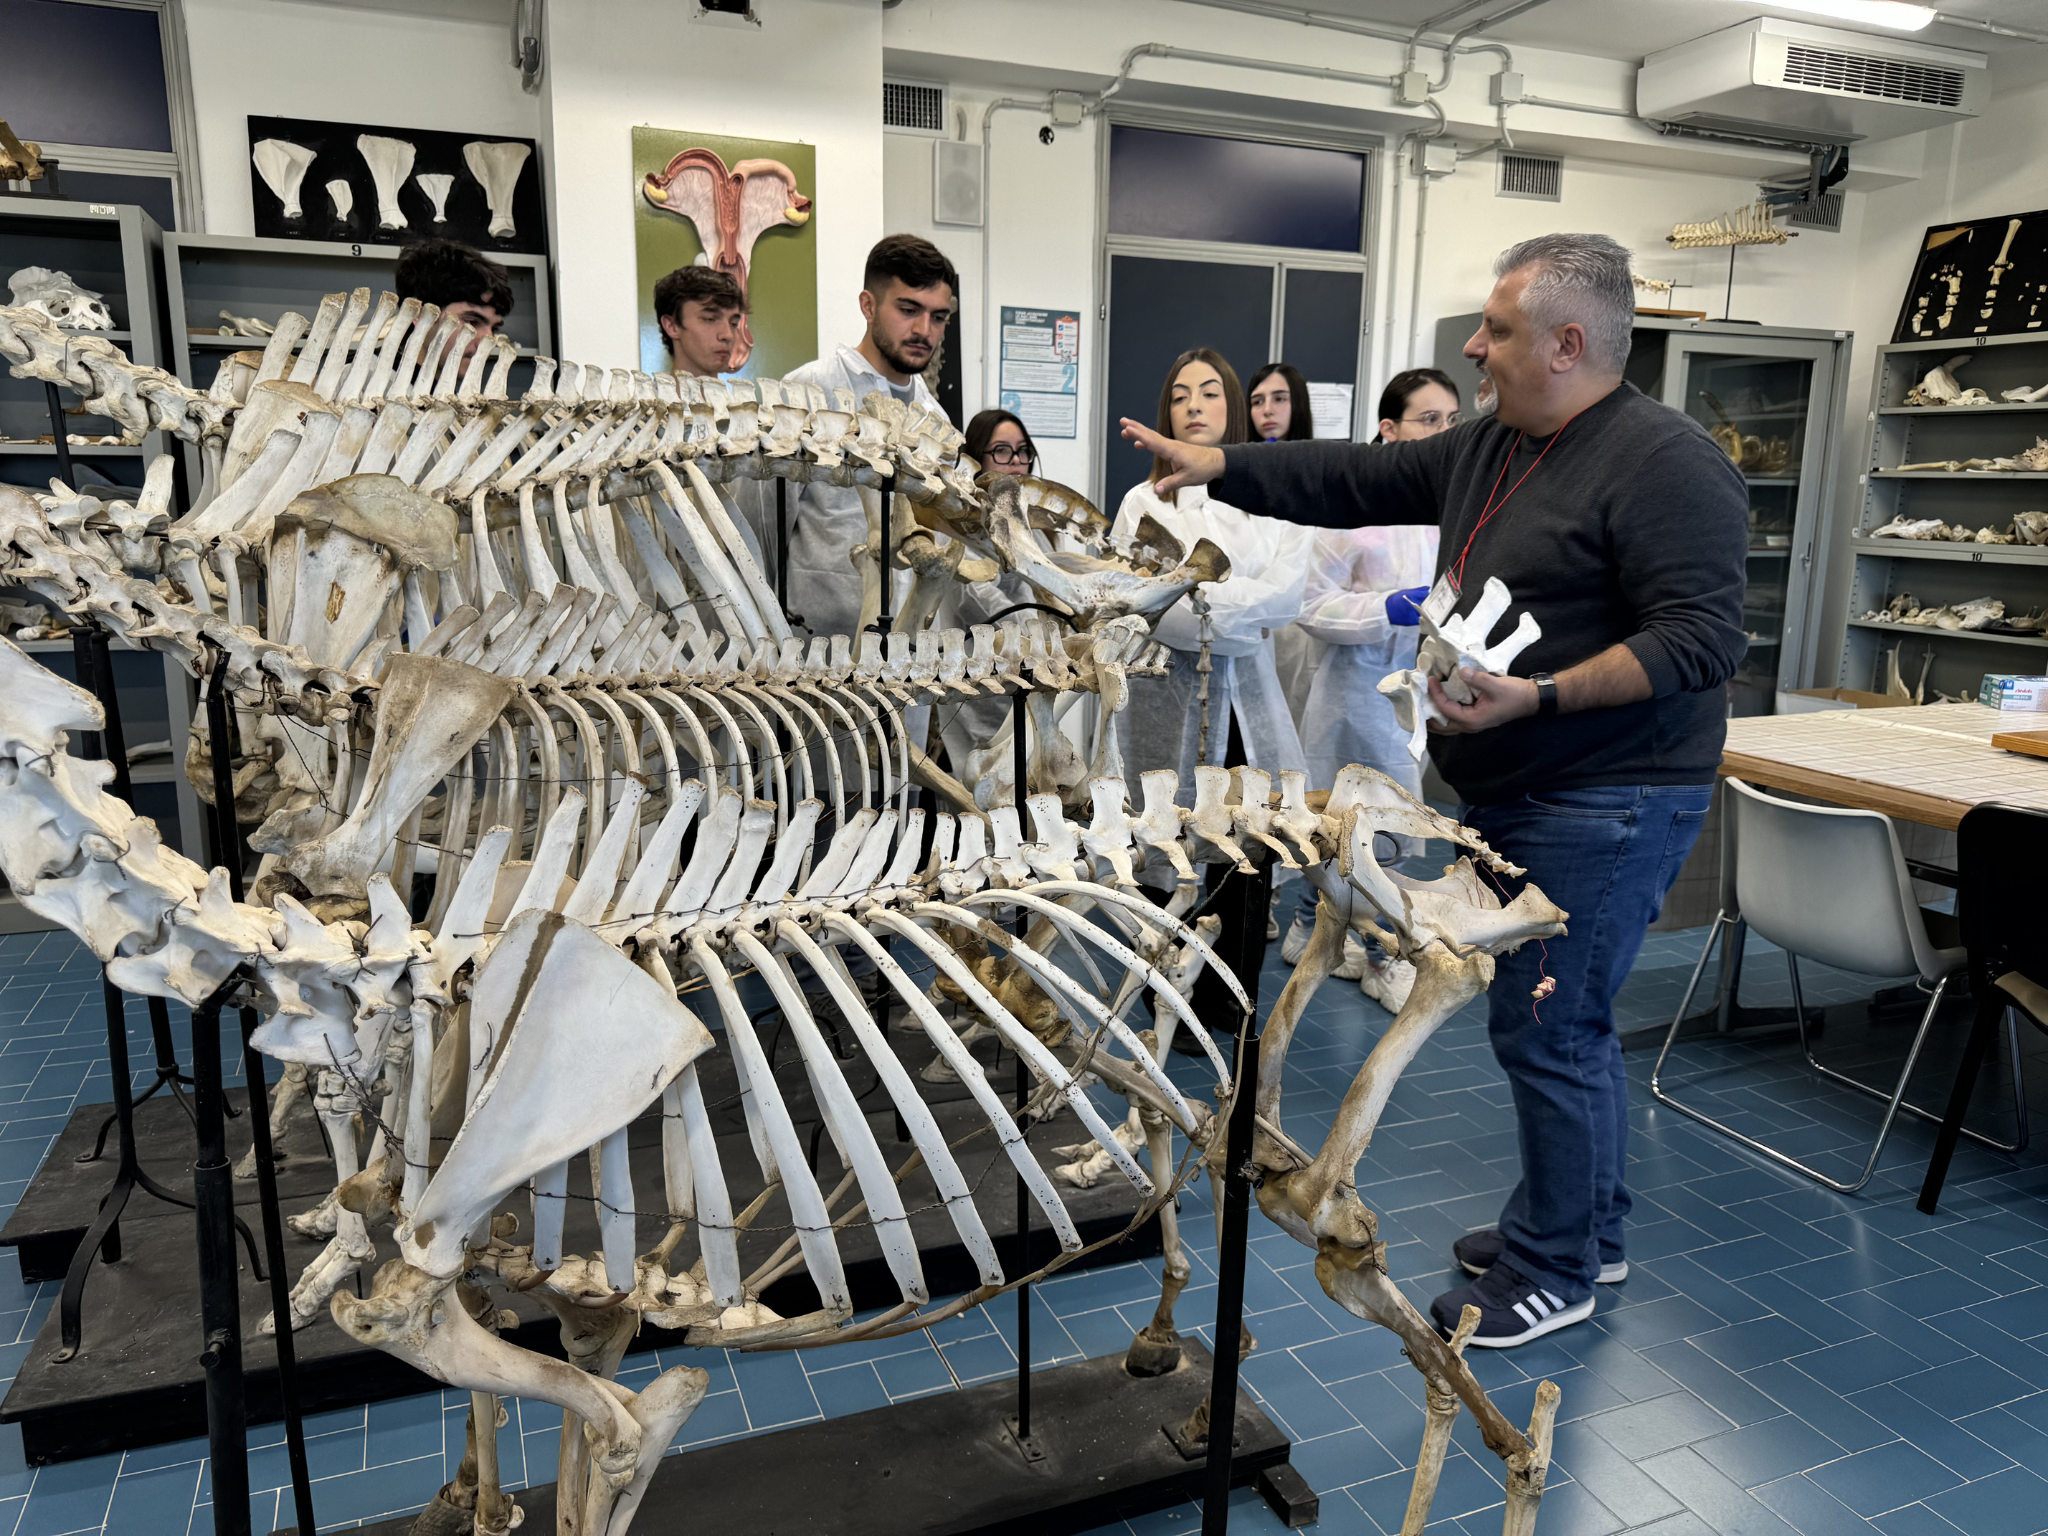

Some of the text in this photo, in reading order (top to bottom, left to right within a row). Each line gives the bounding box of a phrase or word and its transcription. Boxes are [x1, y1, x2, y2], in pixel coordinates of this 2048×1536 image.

[351, 244, 362, 256] 9
[1975, 337, 1987, 346] 10
[1062, 364, 1075, 393] 2
[1971, 552, 1983, 562] 10
